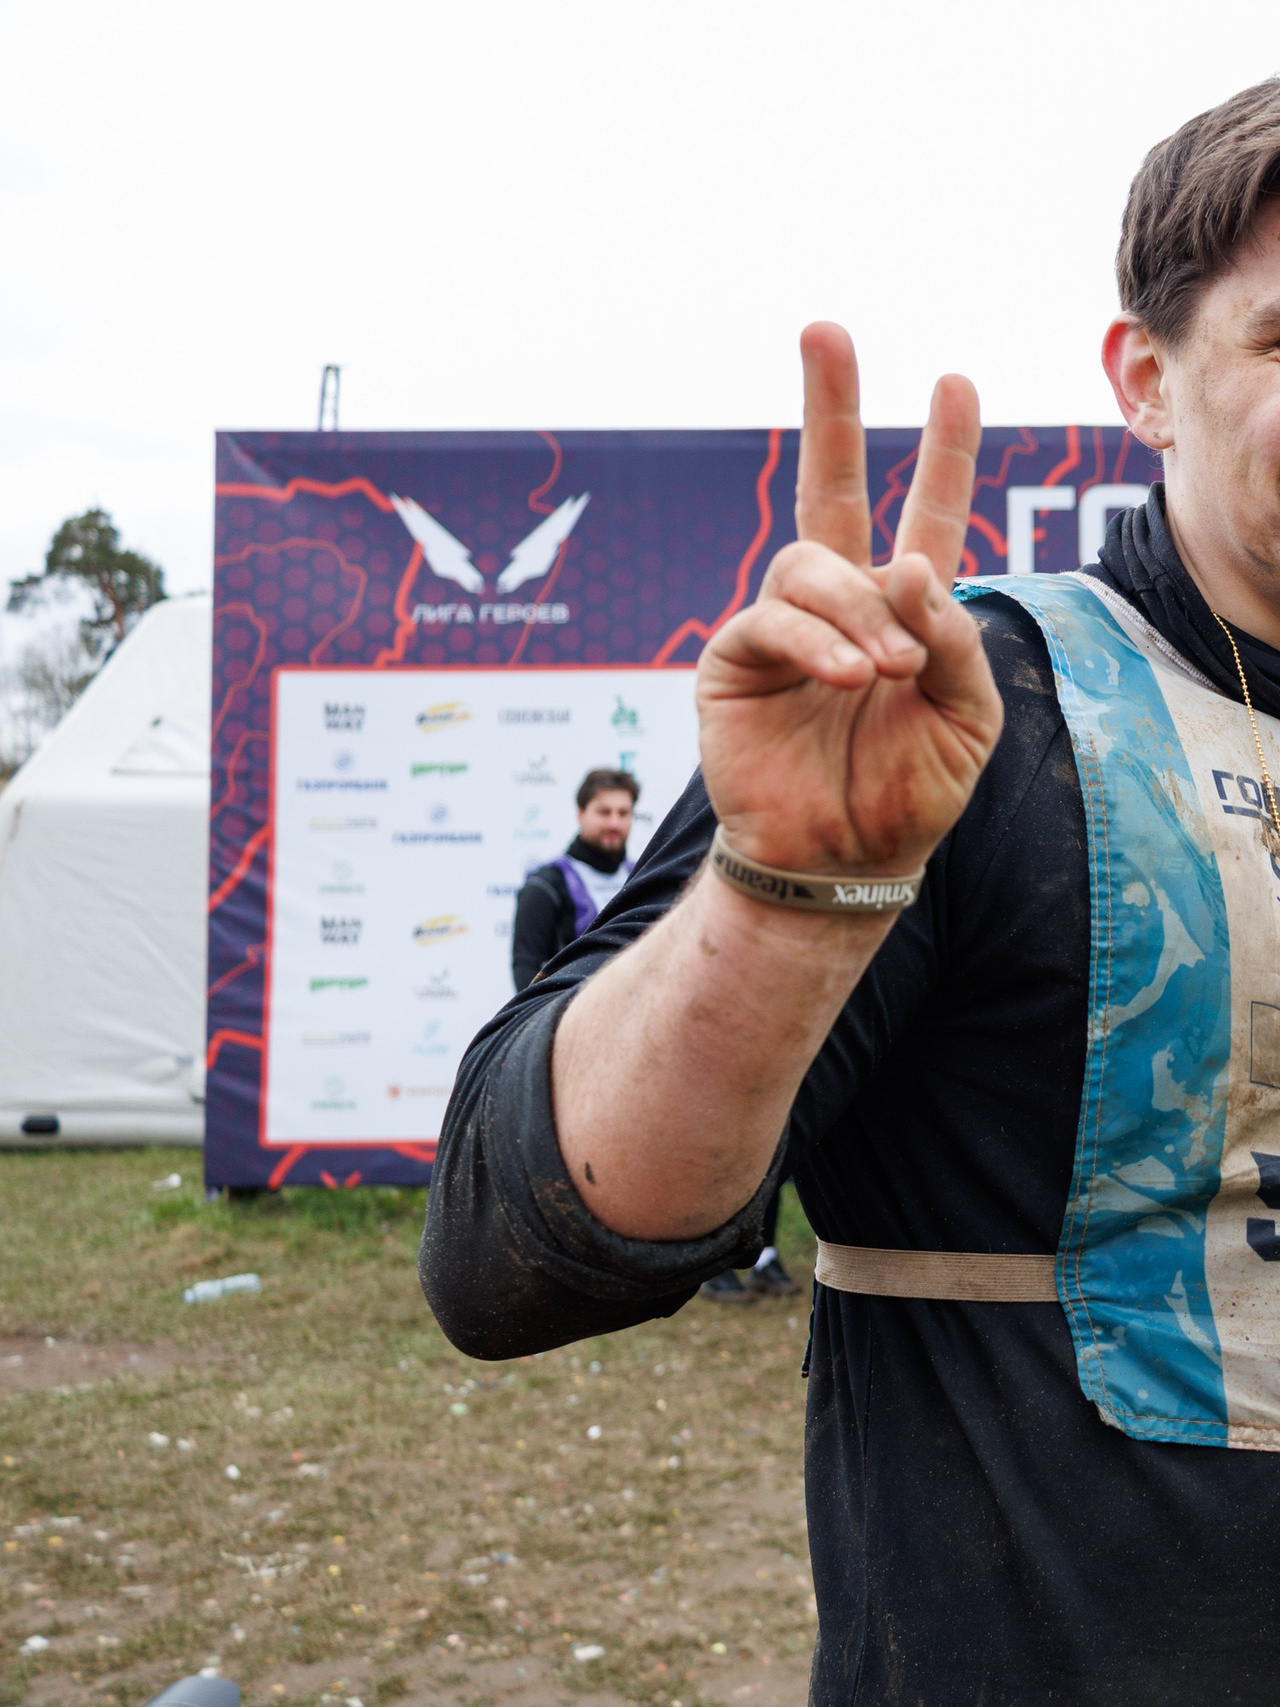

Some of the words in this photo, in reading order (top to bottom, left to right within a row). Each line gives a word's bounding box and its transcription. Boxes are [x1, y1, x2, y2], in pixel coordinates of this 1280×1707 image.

[412, 603, 475, 625] ЛИГА
[479, 602, 571, 625] ГЕРОЕВ
[725, 862, 789, 900] team
[834, 883, 916, 910] Sminex
